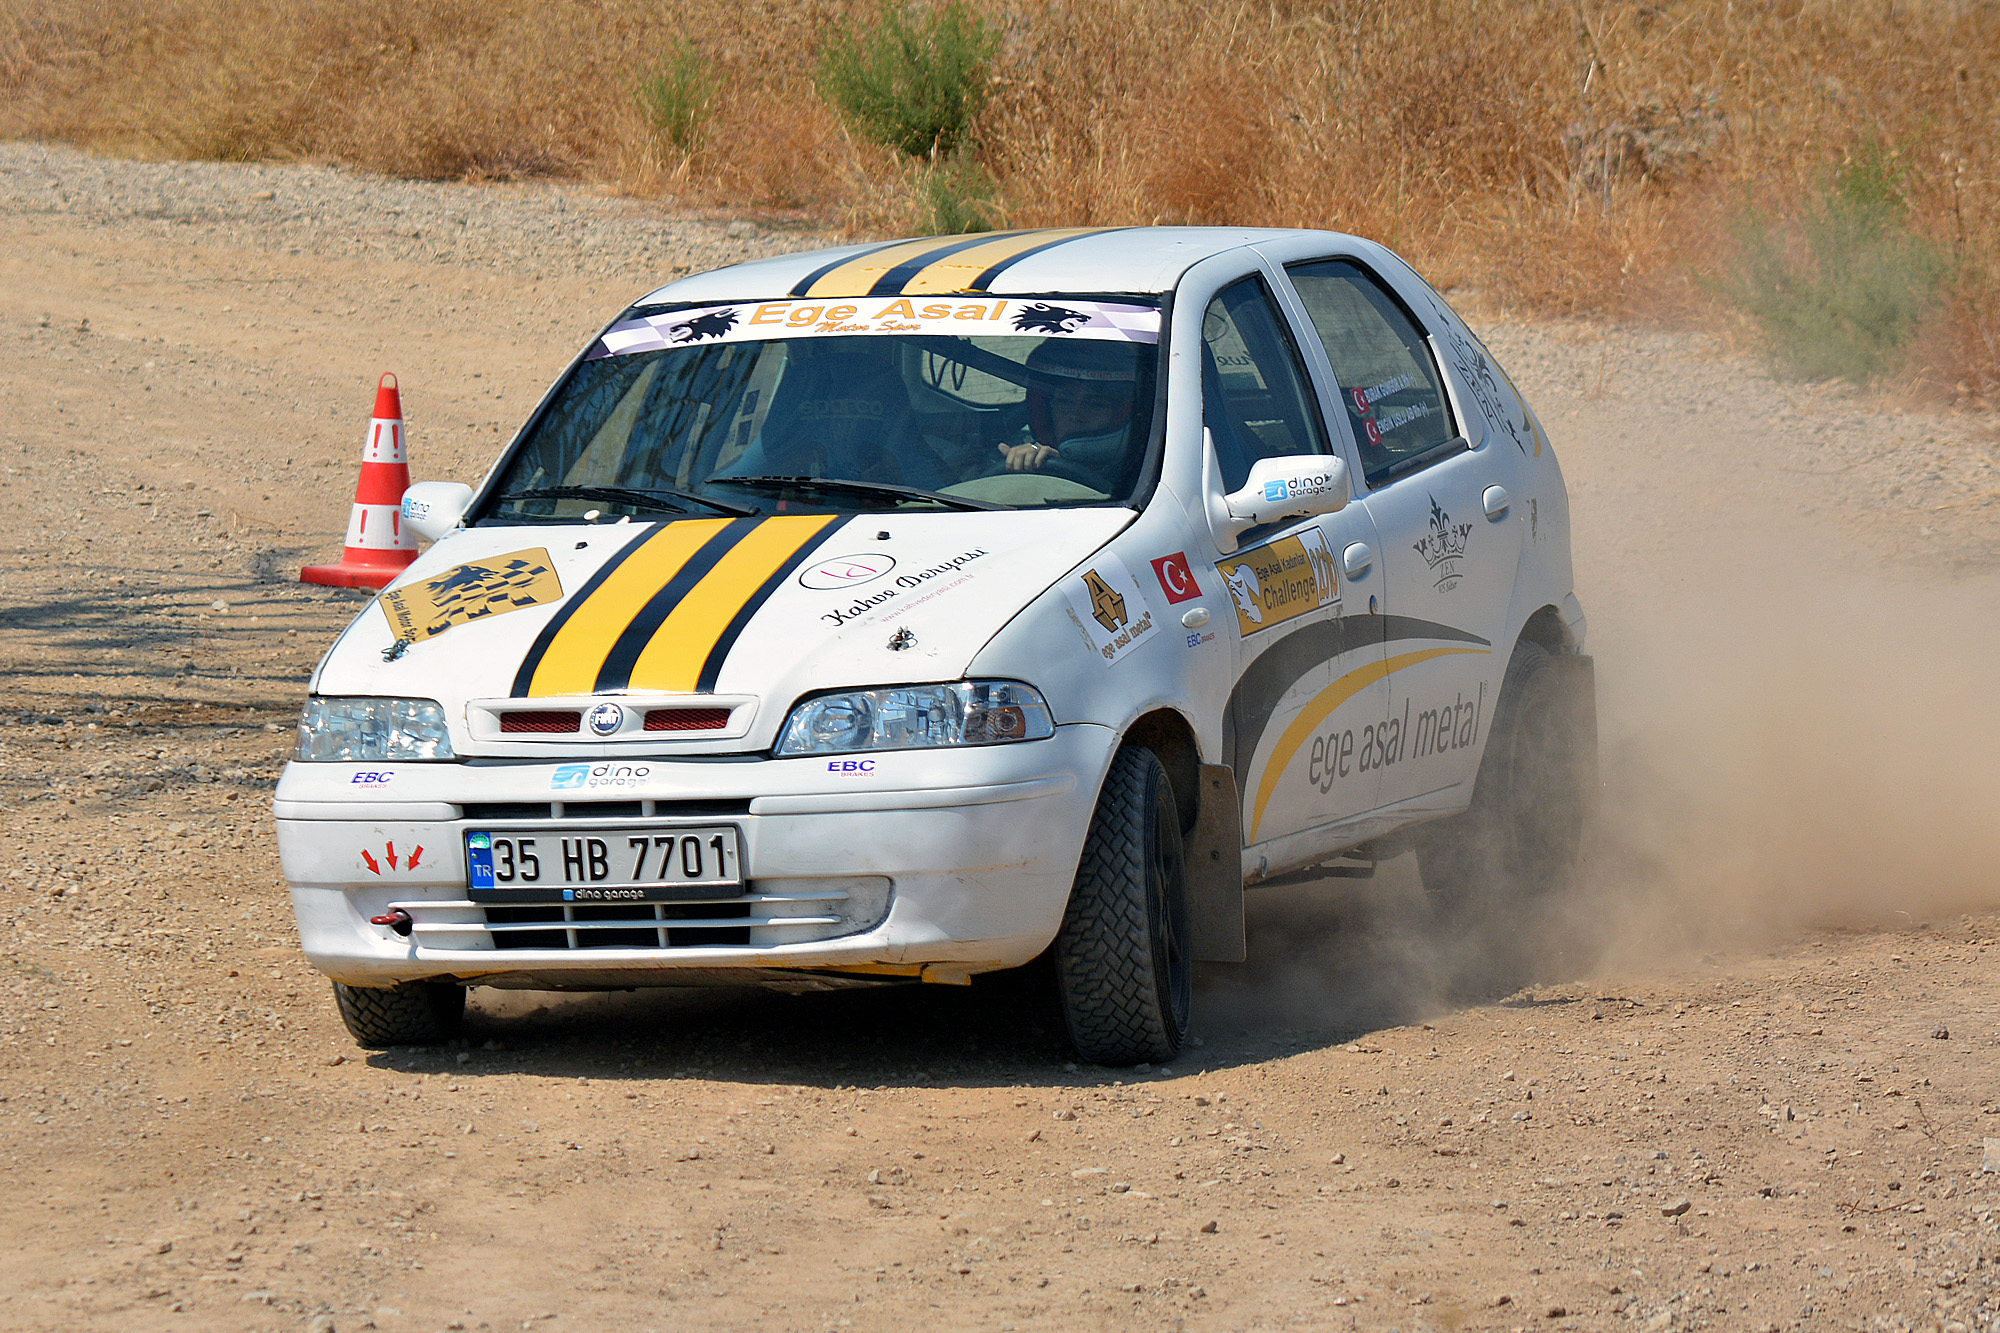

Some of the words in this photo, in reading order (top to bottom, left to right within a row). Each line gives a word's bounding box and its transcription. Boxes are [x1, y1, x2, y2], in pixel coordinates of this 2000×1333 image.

[749, 302, 858, 328] Ege
[871, 299, 1009, 321] Asal
[814, 321, 871, 334] Motor
[874, 320, 922, 334] Spor
[1288, 476, 1324, 489] dino
[1289, 486, 1325, 498] garage
[1255, 567, 1270, 582] Ege
[1268, 560, 1283, 576] Asal
[1440, 560, 1455, 579] ZEN
[1263, 576, 1316, 610] Challenge
[820, 590, 900, 627] Kahve
[1101, 642, 1116, 660] ege
[1113, 627, 1132, 650] asal
[1187, 633, 1201, 648] EBC
[594, 713, 619, 725] FIAT
[1309, 729, 1353, 795] ege
[1359, 698, 1409, 773] asal
[593, 764, 650, 777] dino
[827, 760, 876, 772] EBC
[351, 771, 395, 784] EBC
[493, 838, 540, 882] 35
[561, 838, 609, 881] HB
[628, 834, 727, 880] 7701
[474, 864, 492, 877] TR
[574, 889, 602, 900] dino
[603, 889, 645, 901] garage
